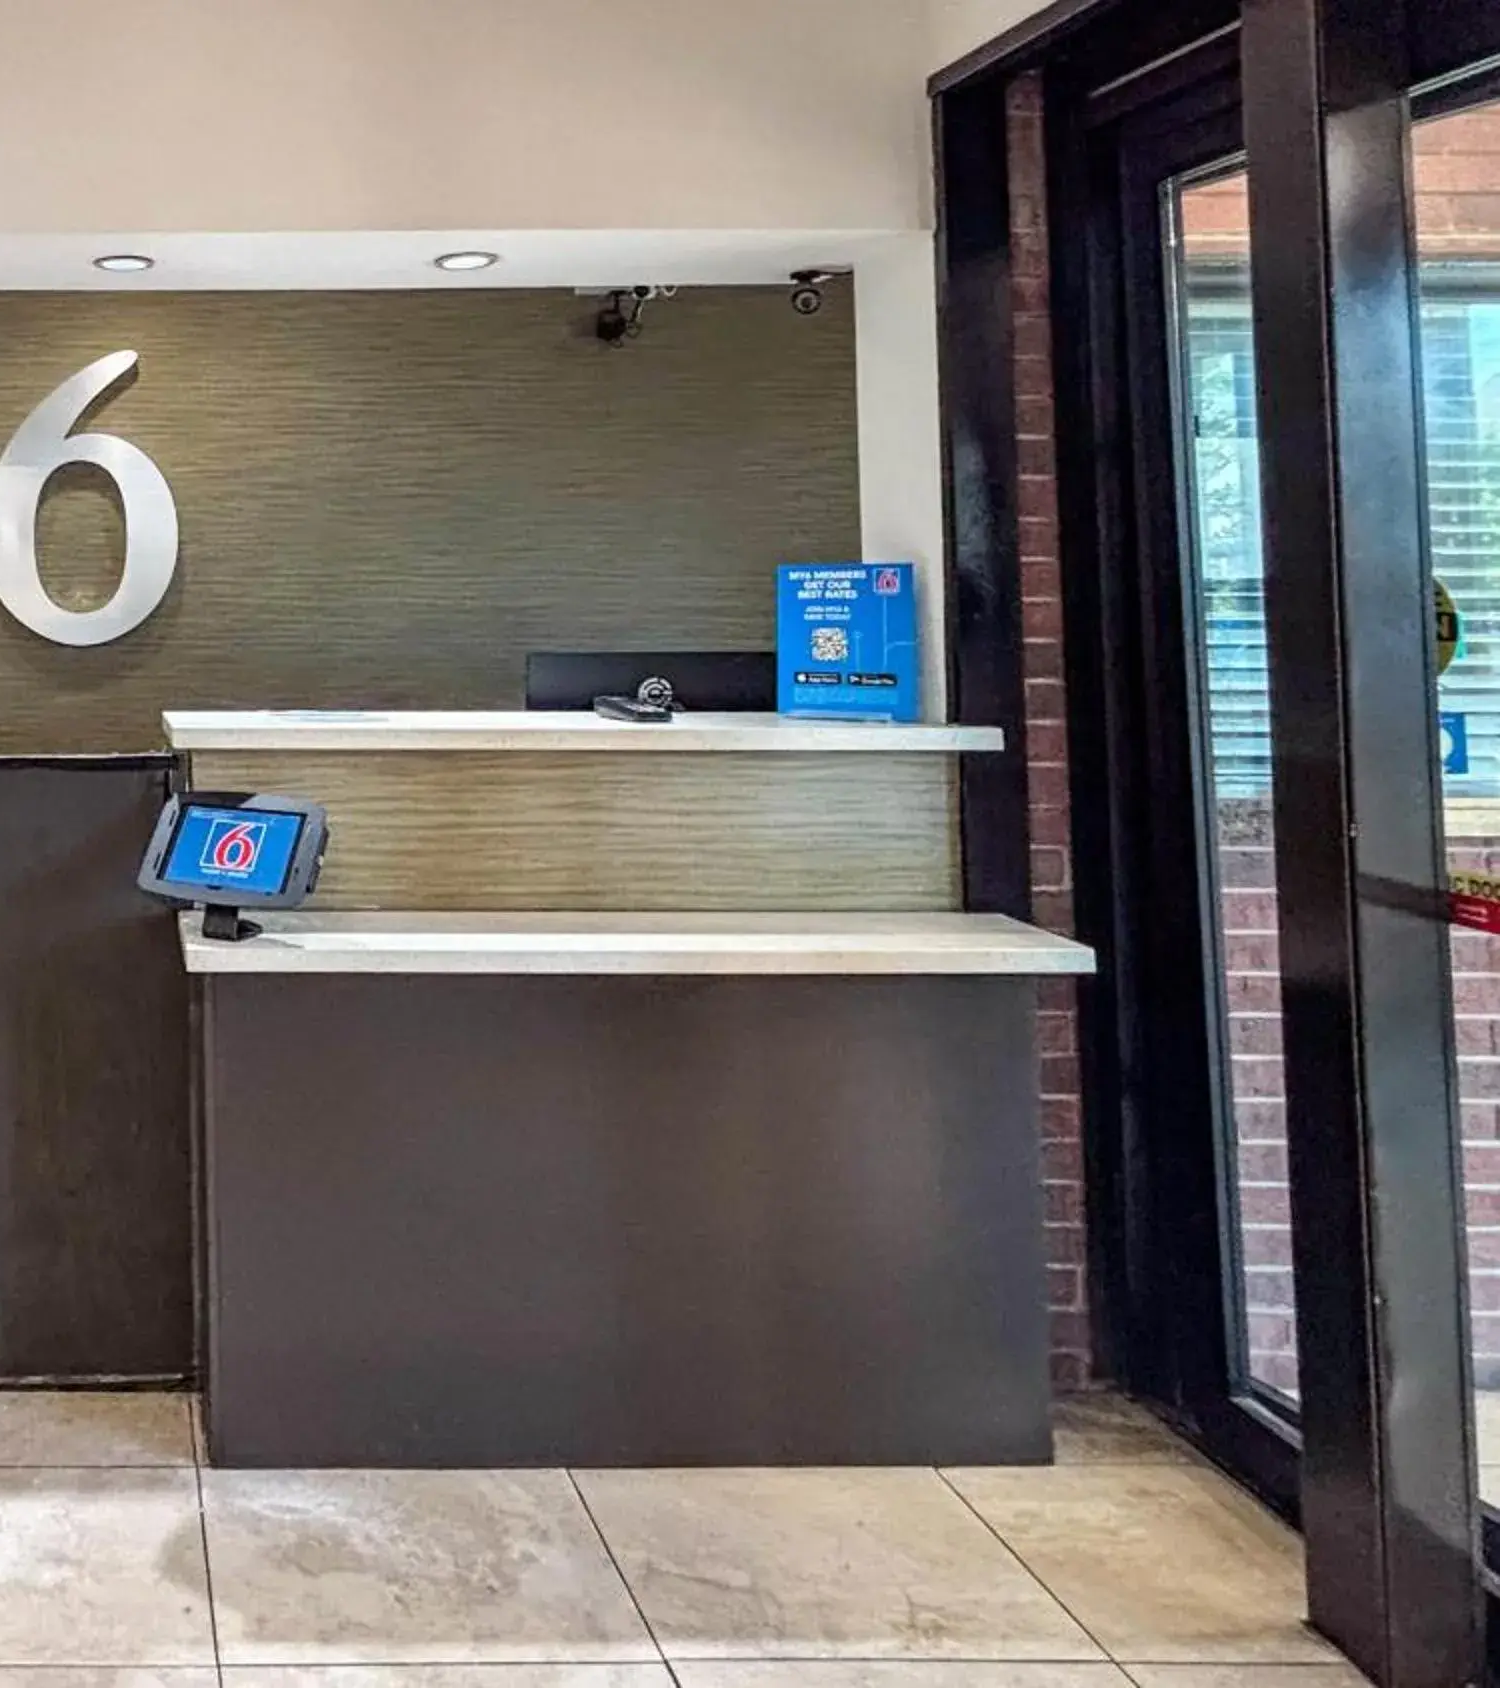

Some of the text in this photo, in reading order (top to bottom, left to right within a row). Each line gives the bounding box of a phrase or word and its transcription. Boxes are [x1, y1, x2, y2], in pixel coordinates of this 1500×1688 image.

[812, 569, 867, 579] MEMBERS
[803, 580, 851, 589] GET OUR
[797, 590, 823, 600] BEST
[214, 821, 254, 870] 6
